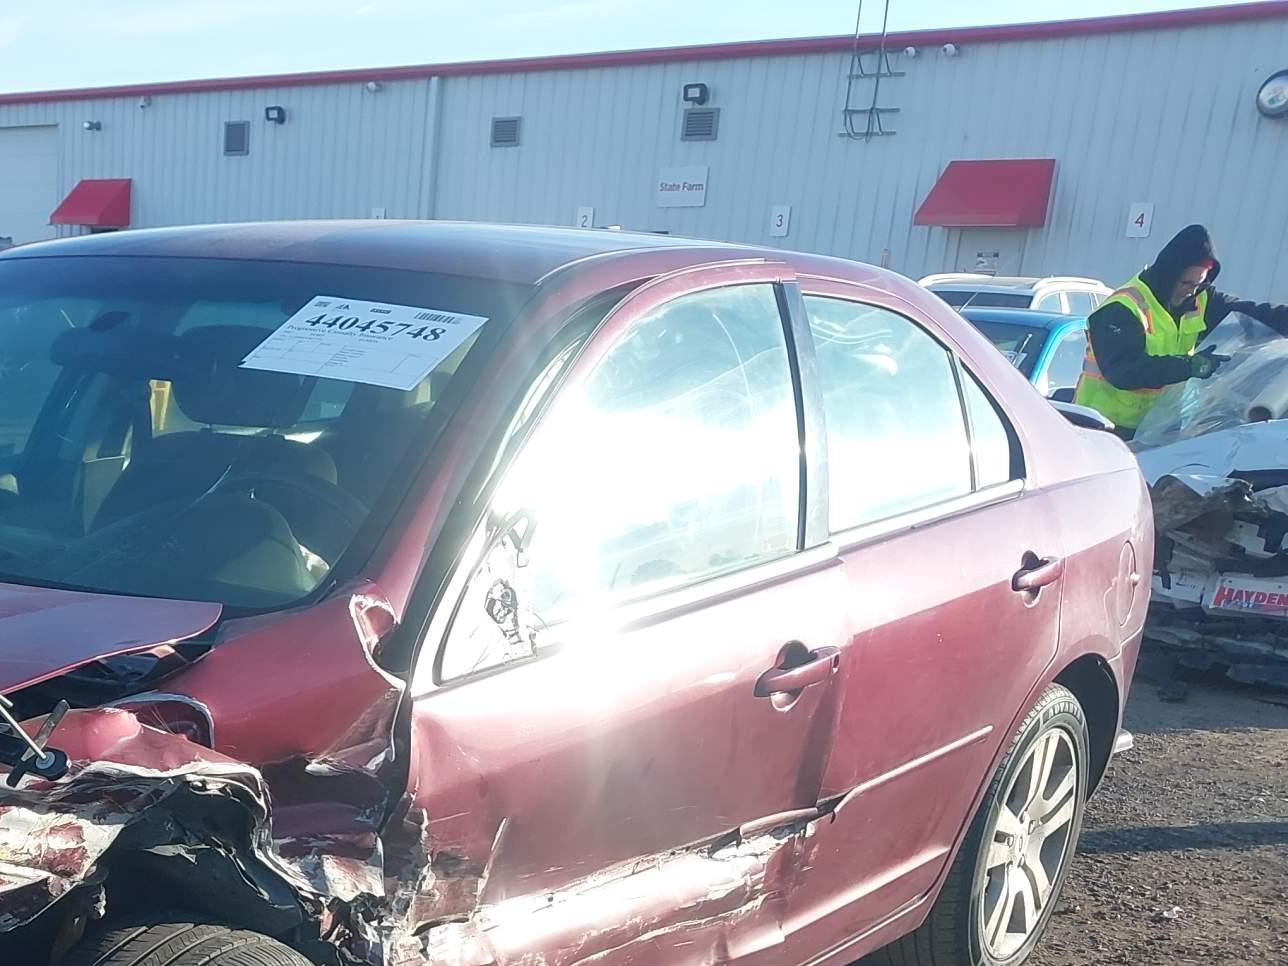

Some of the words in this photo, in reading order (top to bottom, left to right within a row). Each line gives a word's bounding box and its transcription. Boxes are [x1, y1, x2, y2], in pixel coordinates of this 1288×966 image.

[659, 182, 680, 191] State
[682, 181, 704, 191] Farm
[580, 215, 588, 228] 2
[776, 214, 784, 228] 3
[1134, 212, 1145, 228] 4
[306, 313, 447, 342] 44045748
